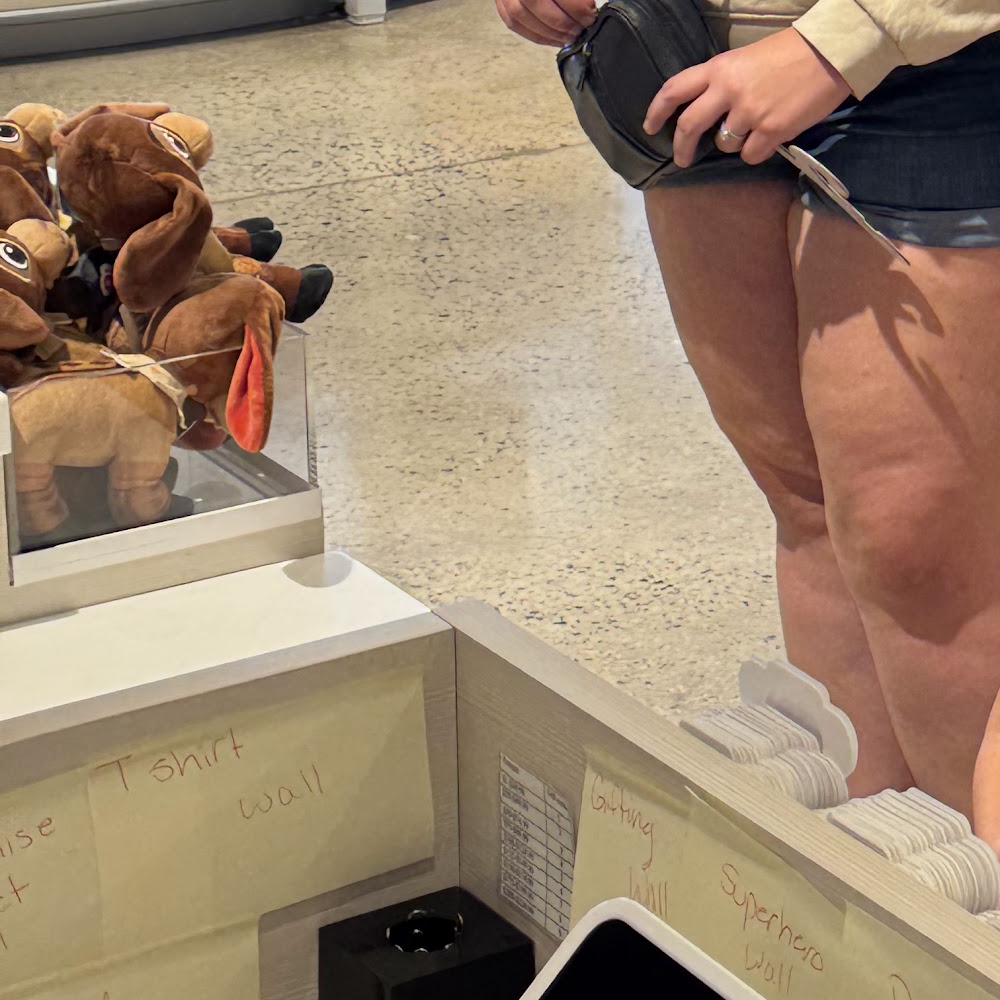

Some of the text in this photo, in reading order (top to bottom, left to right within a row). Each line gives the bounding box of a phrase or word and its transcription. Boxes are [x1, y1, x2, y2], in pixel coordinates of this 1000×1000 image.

[95, 727, 244, 791] T shirt
[720, 862, 824, 972] Superhero
